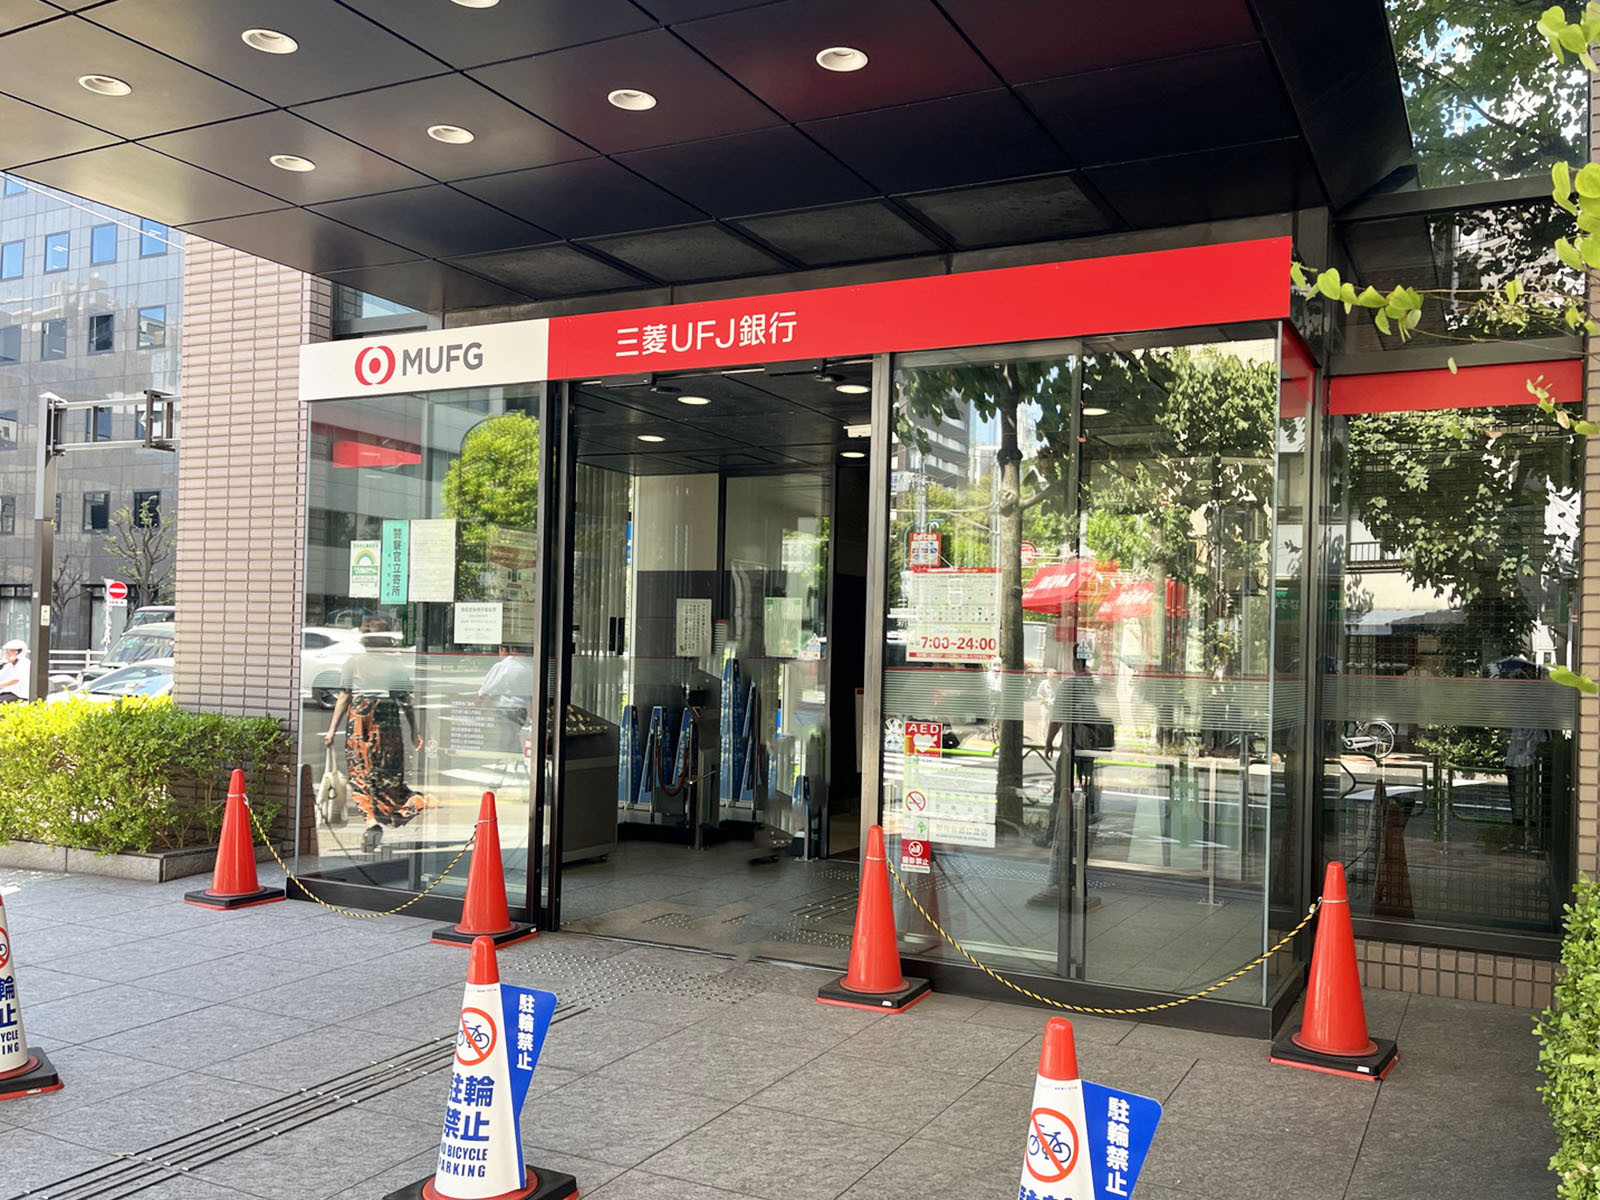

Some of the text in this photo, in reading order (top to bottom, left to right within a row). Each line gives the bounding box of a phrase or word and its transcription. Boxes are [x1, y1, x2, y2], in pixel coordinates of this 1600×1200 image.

[615, 311, 797, 357] 三菱UFJ銀行
[402, 342, 484, 376] MUFG
[907, 723, 939, 734] AED
[516, 993, 536, 1071] 駐輪禁止
[447, 1144, 488, 1161] BICYCLE
[1105, 1096, 1131, 1197] 駐輪禁止
